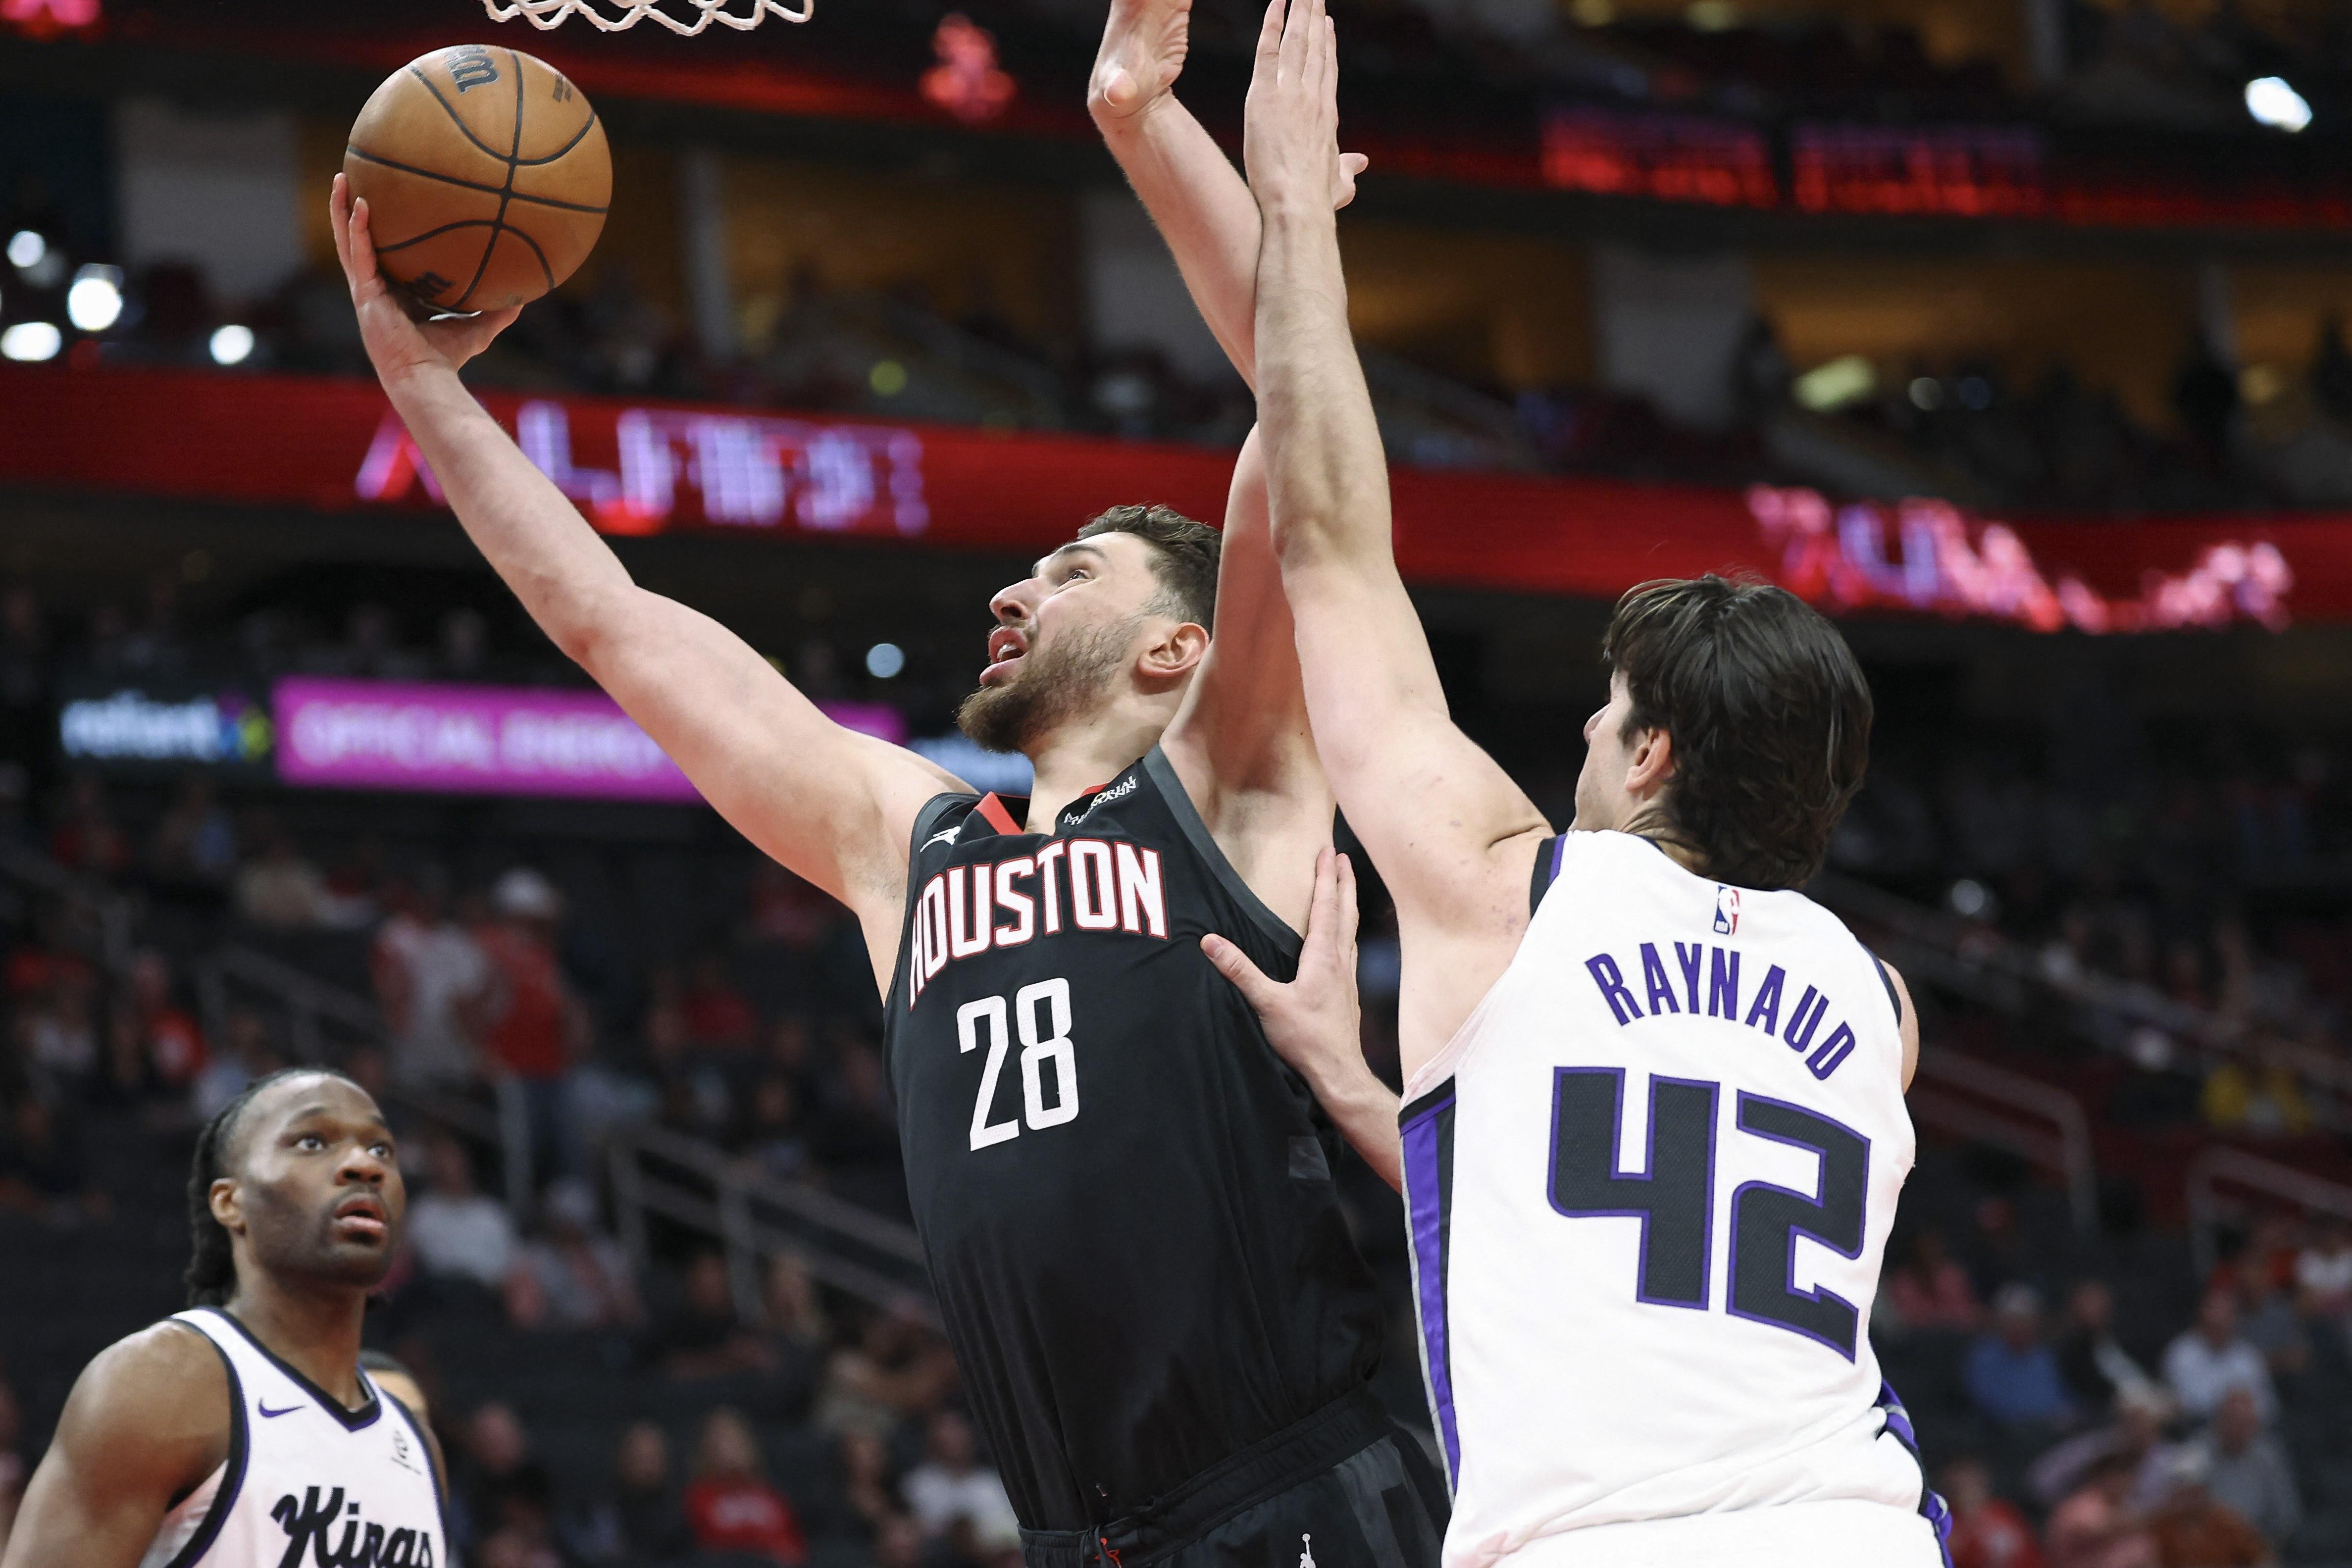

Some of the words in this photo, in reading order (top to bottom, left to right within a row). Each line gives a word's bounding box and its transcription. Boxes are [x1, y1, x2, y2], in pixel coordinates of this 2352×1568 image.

[909, 838, 1168, 1012] HOUSTON
[1585, 941, 1856, 1081] RAYNAUD
[957, 977, 1079, 1152] 28
[1547, 1066, 1871, 1365] 42
